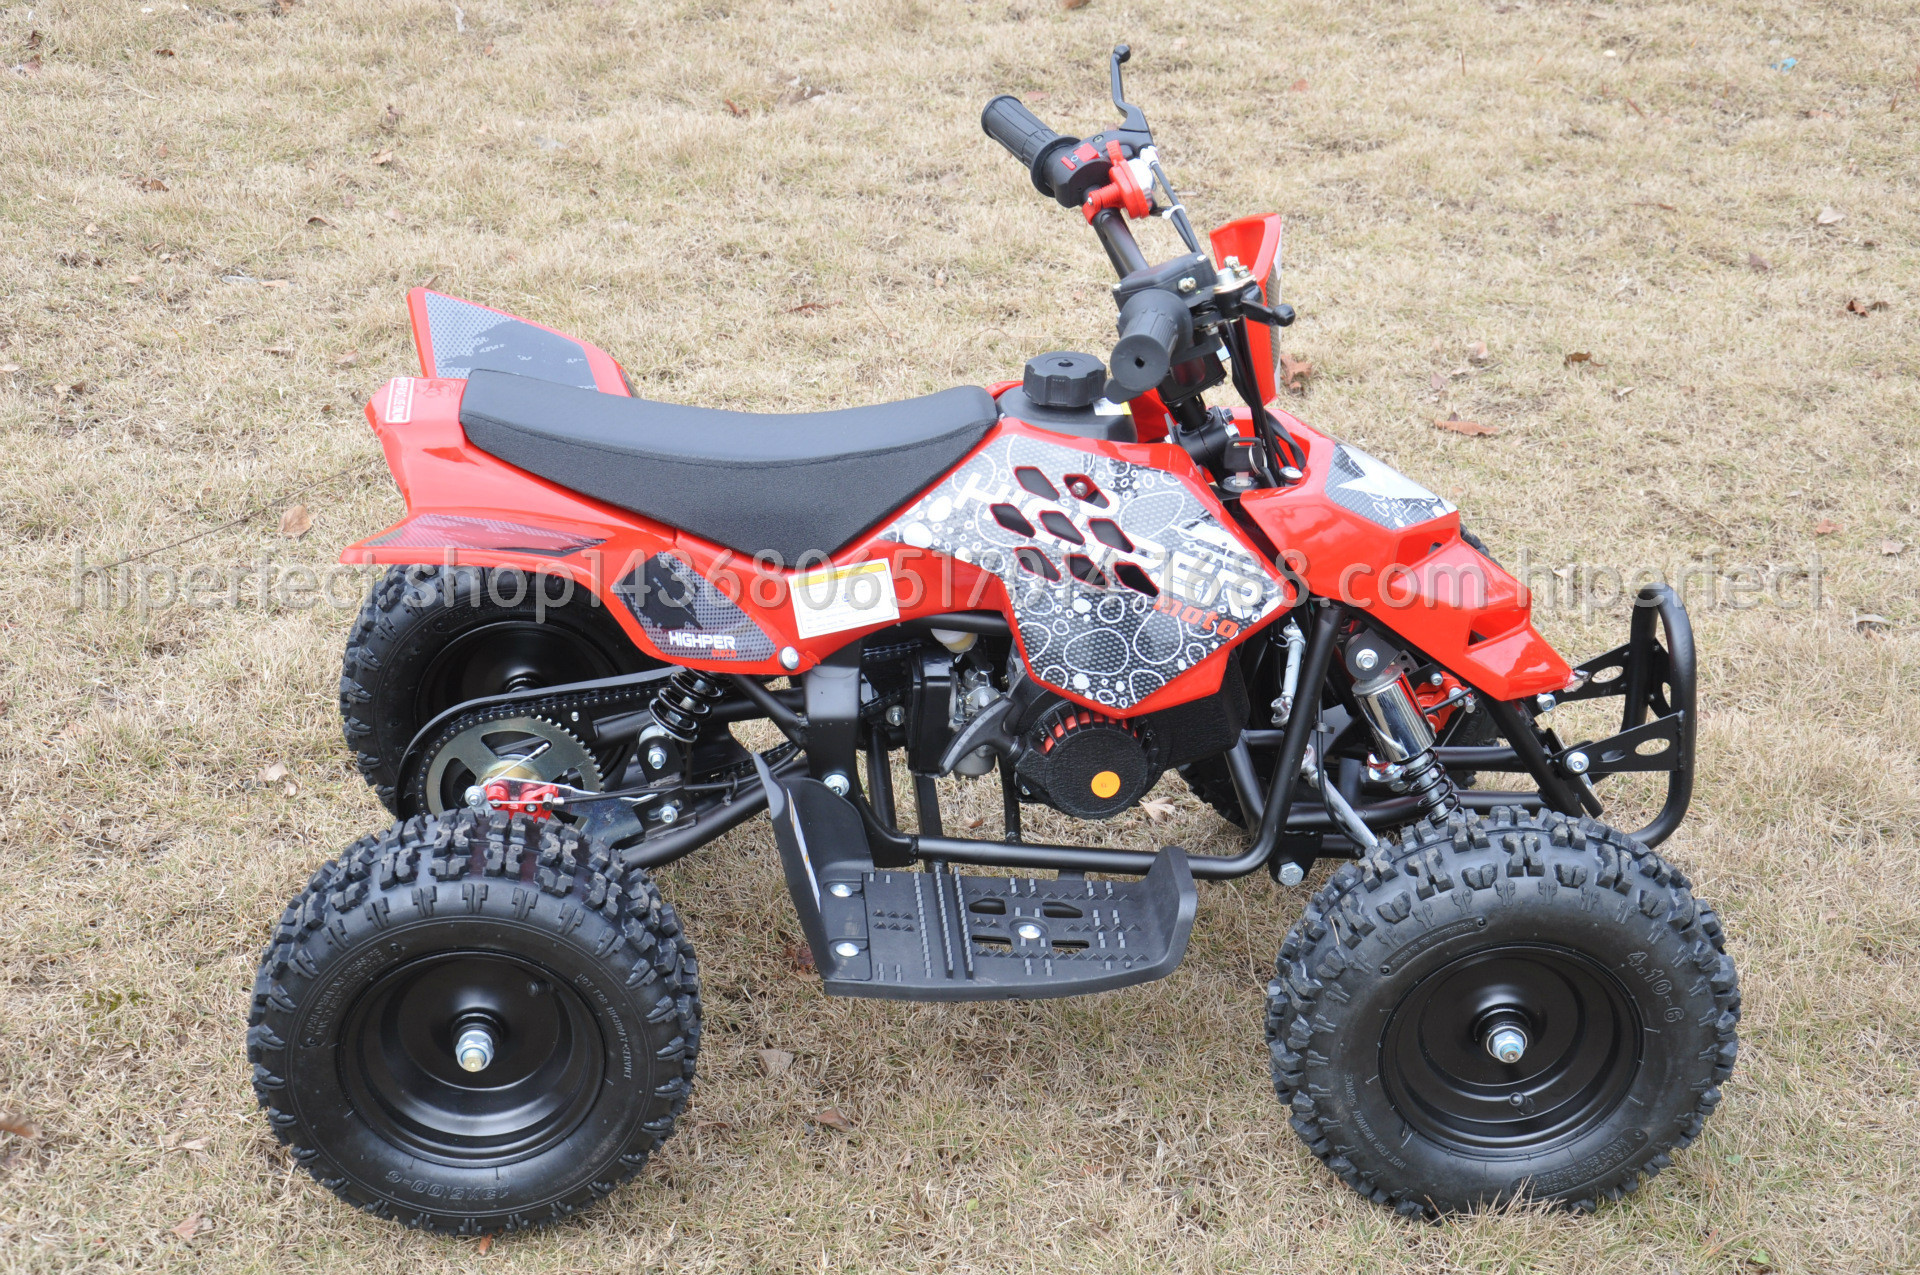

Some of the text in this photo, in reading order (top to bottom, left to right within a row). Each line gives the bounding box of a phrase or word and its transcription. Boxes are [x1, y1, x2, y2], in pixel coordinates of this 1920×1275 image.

[668, 631, 735, 649] HIGHPER
[1153, 595, 1239, 638] moto
[712, 649, 737, 658] moto
[577, 973, 594, 988] NOT
[593, 989, 608, 1005] FOR
[606, 1006, 629, 1043] HIGHWAY
[1627, 951, 1684, 1022] 4.10-6
[1344, 1073, 1406, 1170] NOT FOR HIGHWAY SERVICE
